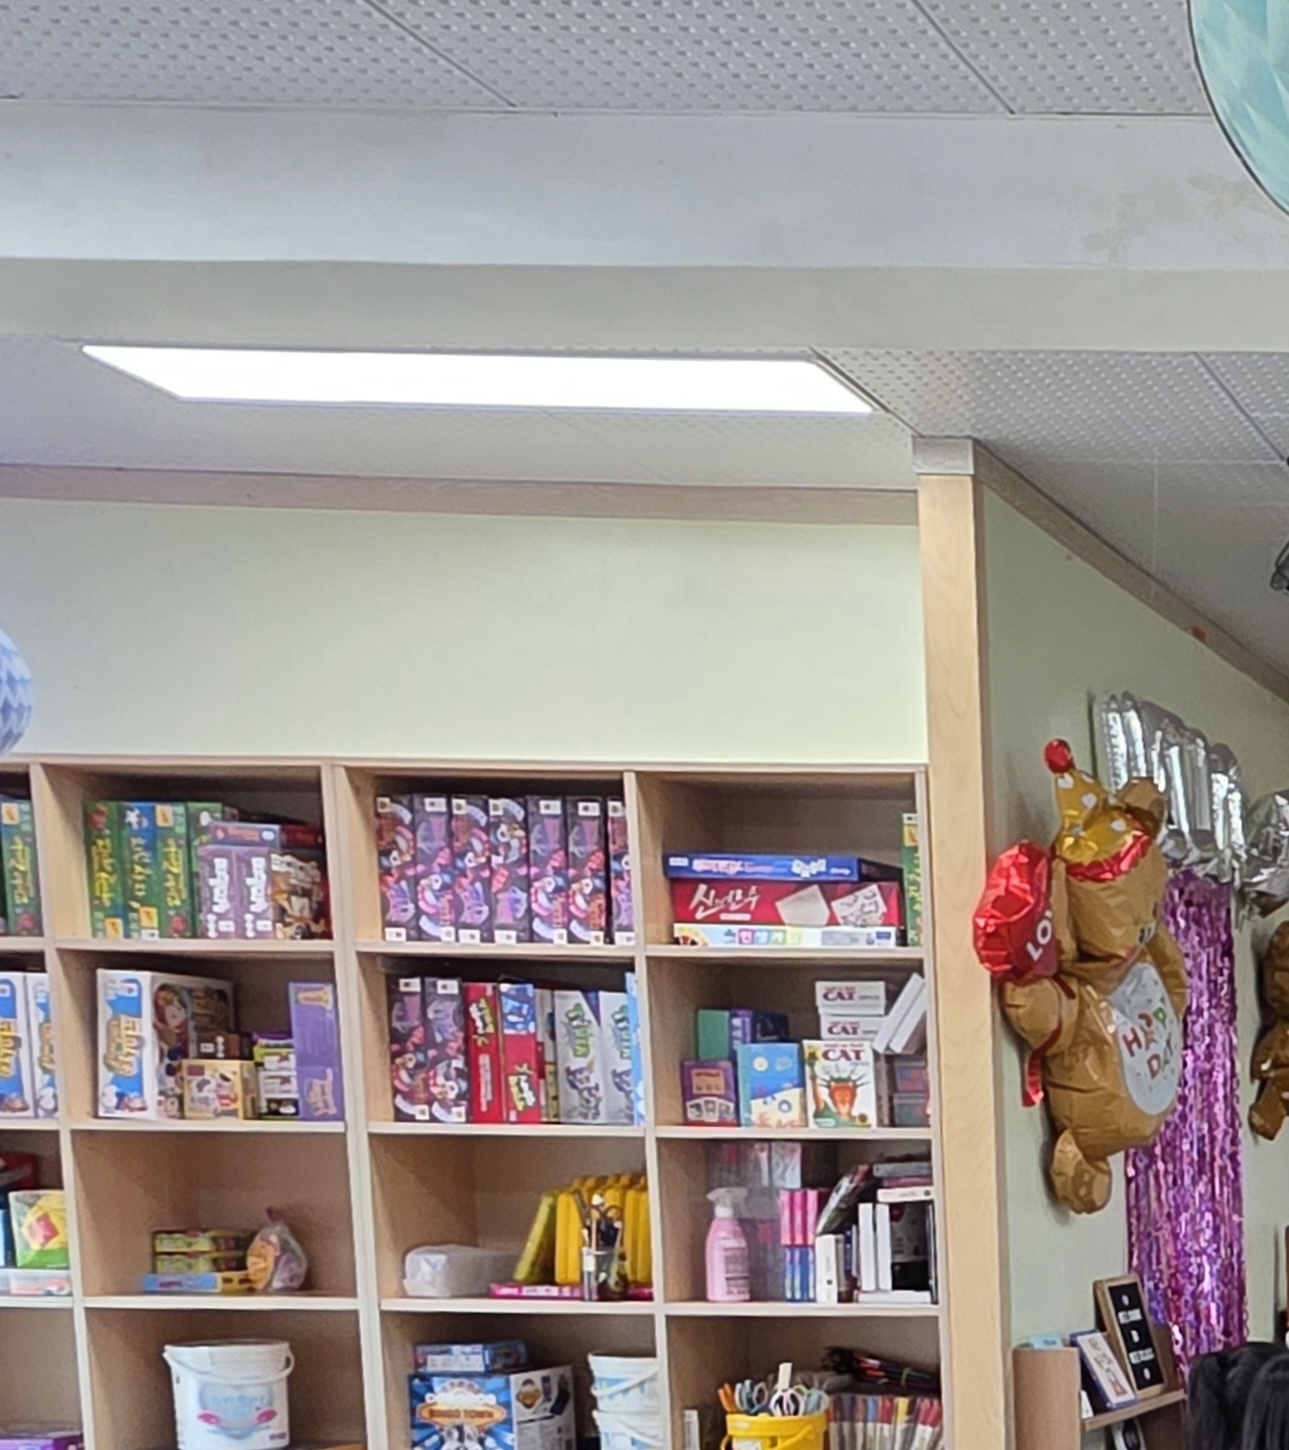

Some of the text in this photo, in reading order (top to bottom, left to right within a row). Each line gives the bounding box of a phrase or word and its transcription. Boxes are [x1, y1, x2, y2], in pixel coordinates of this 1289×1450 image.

[822, 989, 857, 1002] CAT
[828, 1024, 862, 1036] CAT
[822, 1049, 866, 1062] CAT
